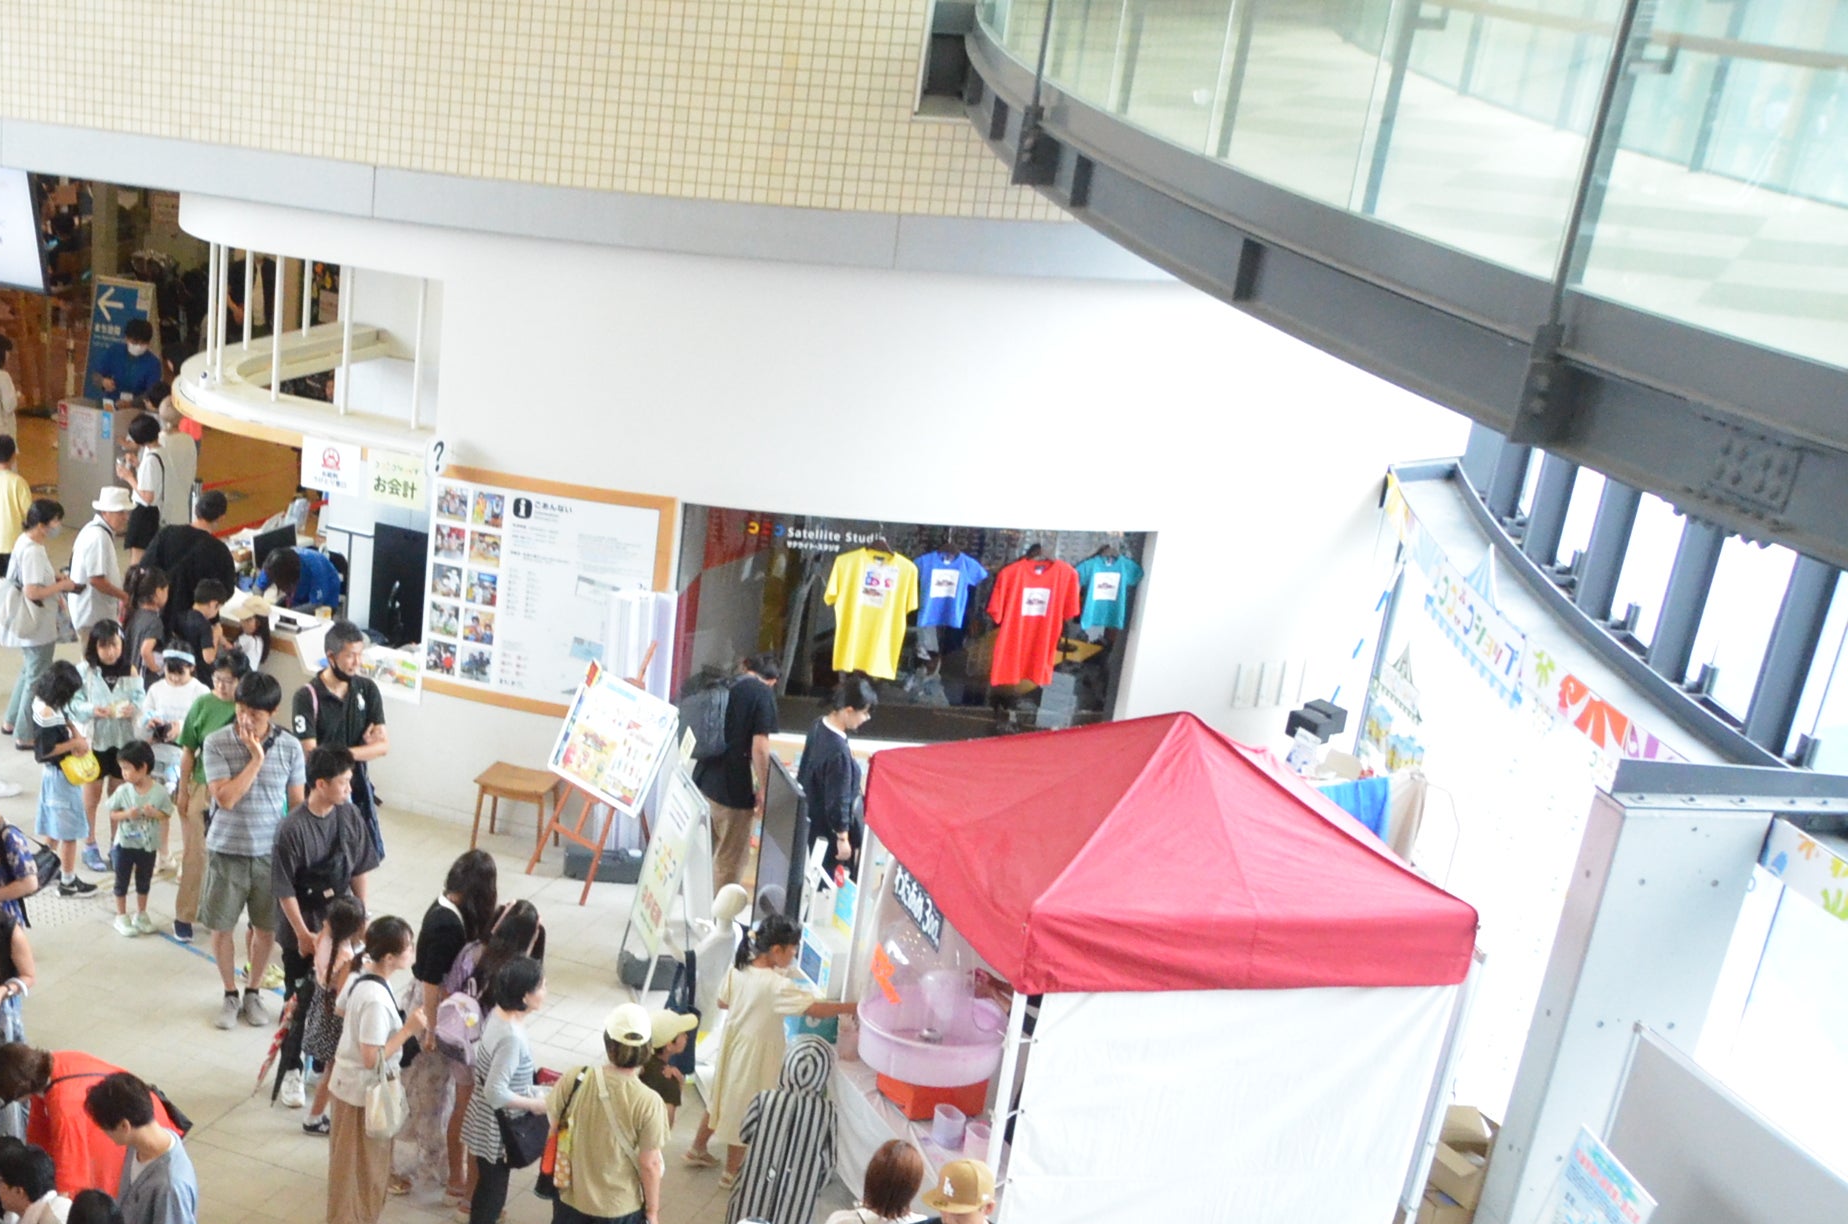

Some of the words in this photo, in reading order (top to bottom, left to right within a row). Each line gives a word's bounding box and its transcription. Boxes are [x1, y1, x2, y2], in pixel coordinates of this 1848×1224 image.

[373, 474, 418, 500] お会計
[787, 527, 842, 543] Satellite
[293, 714, 308, 733] 3
